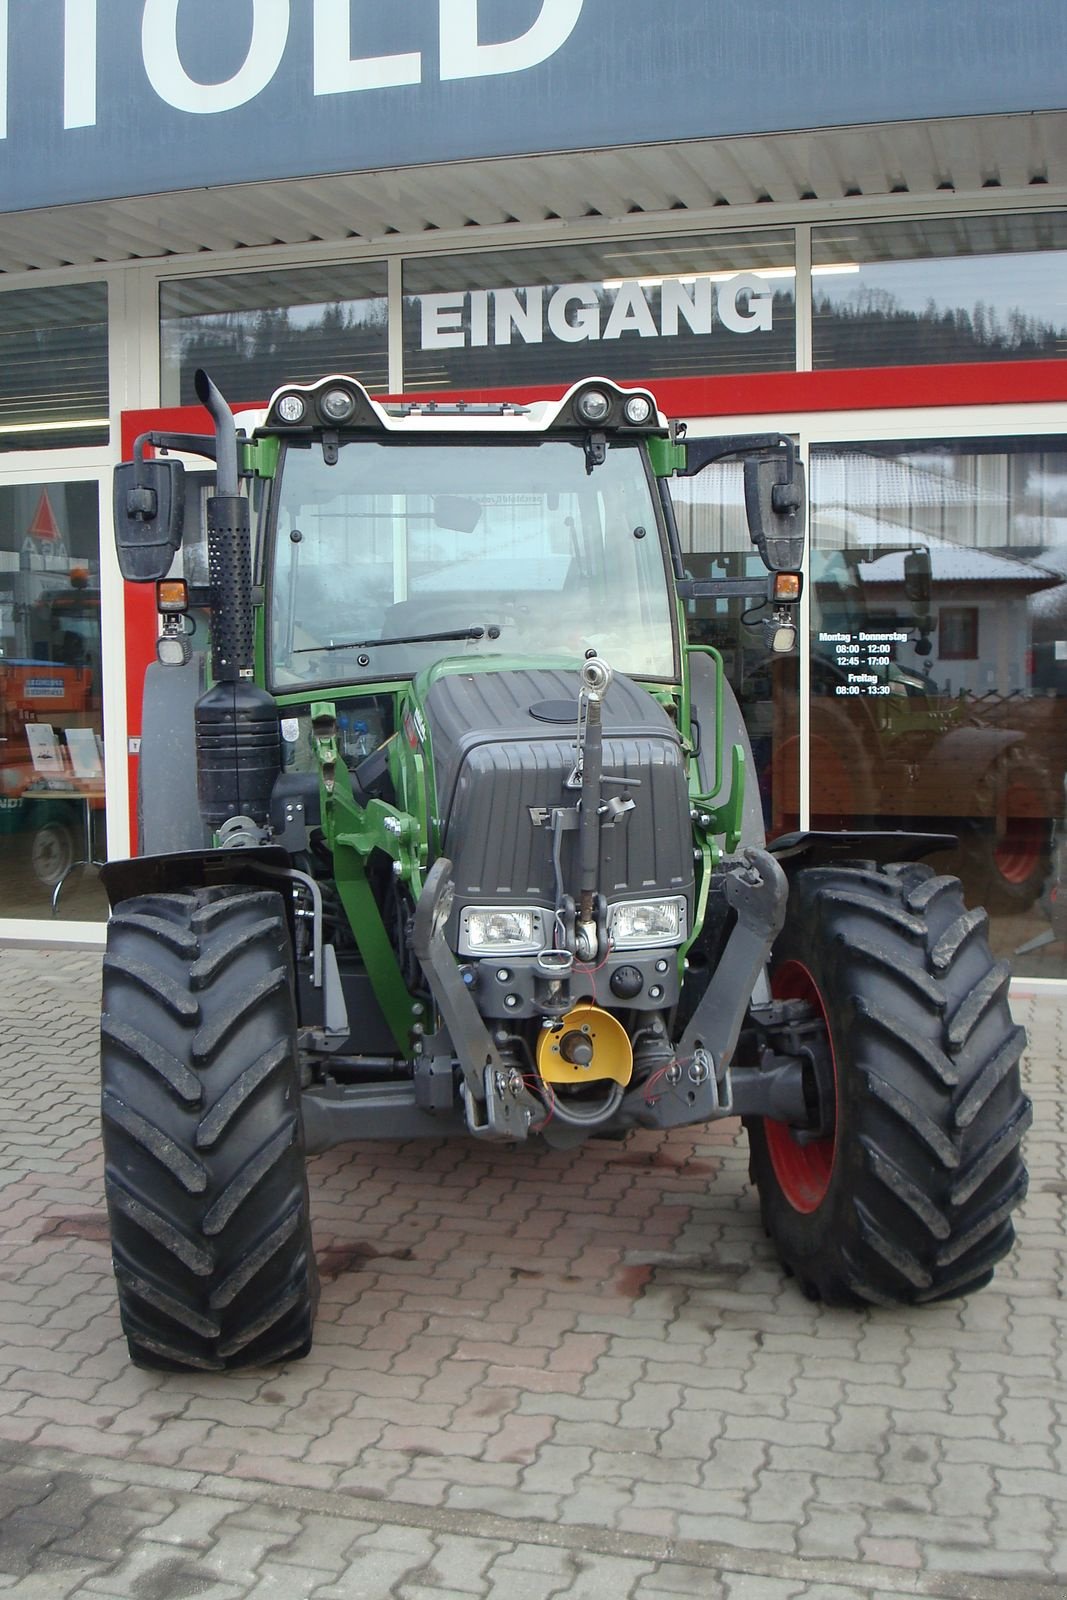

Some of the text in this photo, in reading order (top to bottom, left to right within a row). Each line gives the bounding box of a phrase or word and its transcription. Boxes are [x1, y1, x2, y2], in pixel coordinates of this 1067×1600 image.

[420, 273, 773, 350] EINGANG
[819, 632, 851, 642] Montag
[859, 632, 908, 642] Donnerstag
[836, 644, 860, 653] 08:00
[868, 644, 891, 653] 12:00
[837, 656, 860, 665] 12:45
[868, 656, 890, 665] 17:00
[848, 674, 878, 683] Freitag
[836, 686, 860, 695] 08:00
[868, 686, 891, 695] 13:30
